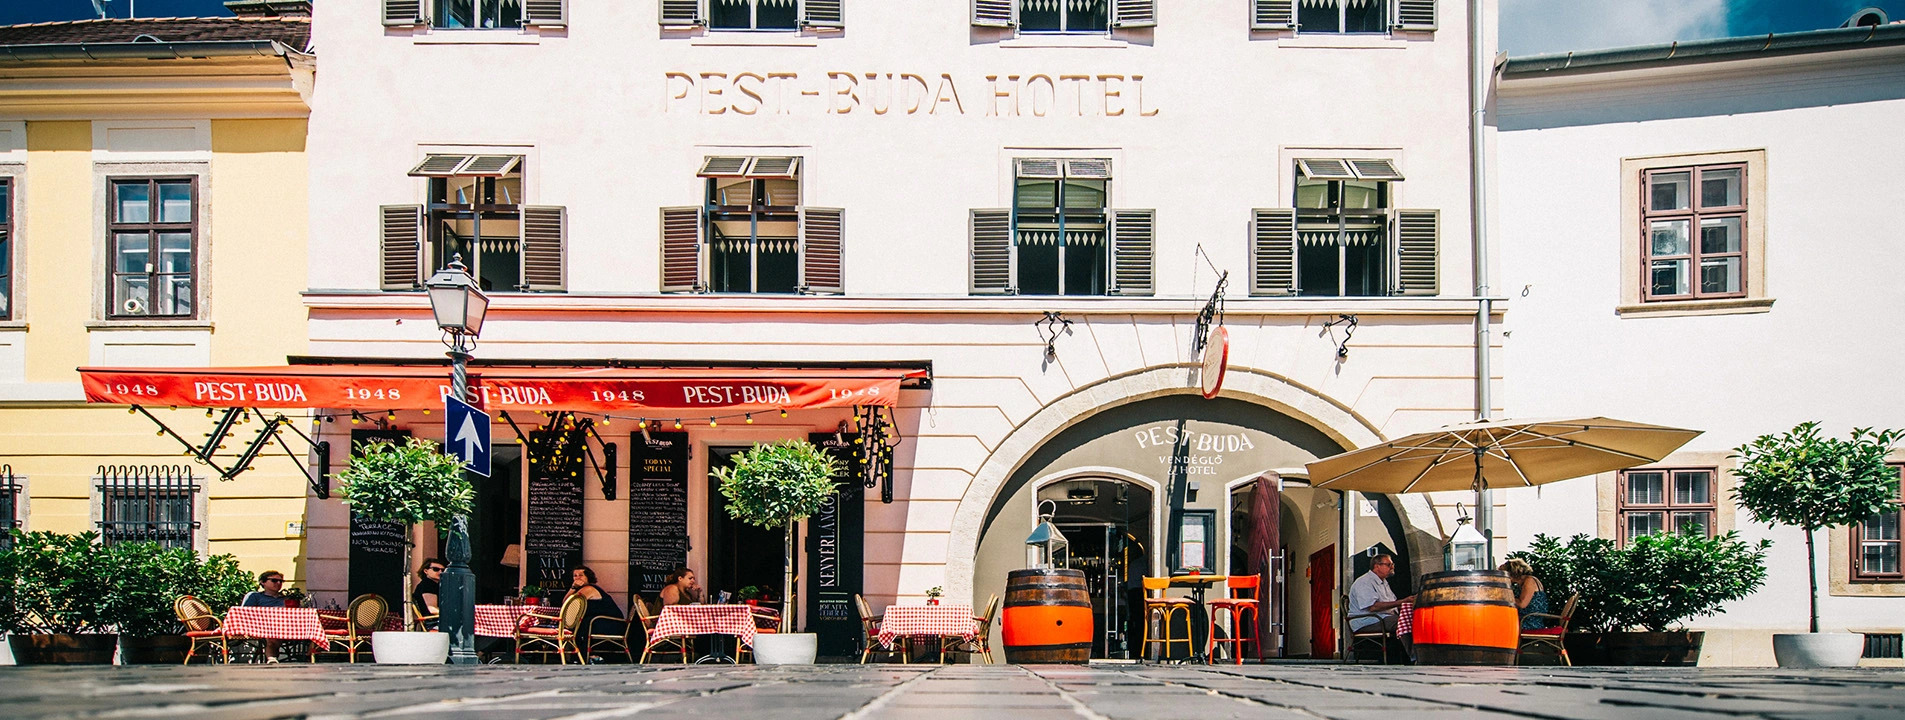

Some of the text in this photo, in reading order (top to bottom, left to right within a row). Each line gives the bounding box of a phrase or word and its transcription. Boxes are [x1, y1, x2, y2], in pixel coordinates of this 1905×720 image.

[665, 71, 1160, 117] PEST-BUDA HOTEL
[103, 381, 880, 405] 1948 PEST·BUDA 1948 PST·BUDA 1948 PEST·BUDA 1948
[1134, 425, 1255, 453] PEST·BUDA
[1158, 454, 1224, 465] VENDÉGLŐ
[1180, 465, 1217, 475] HOTEL
